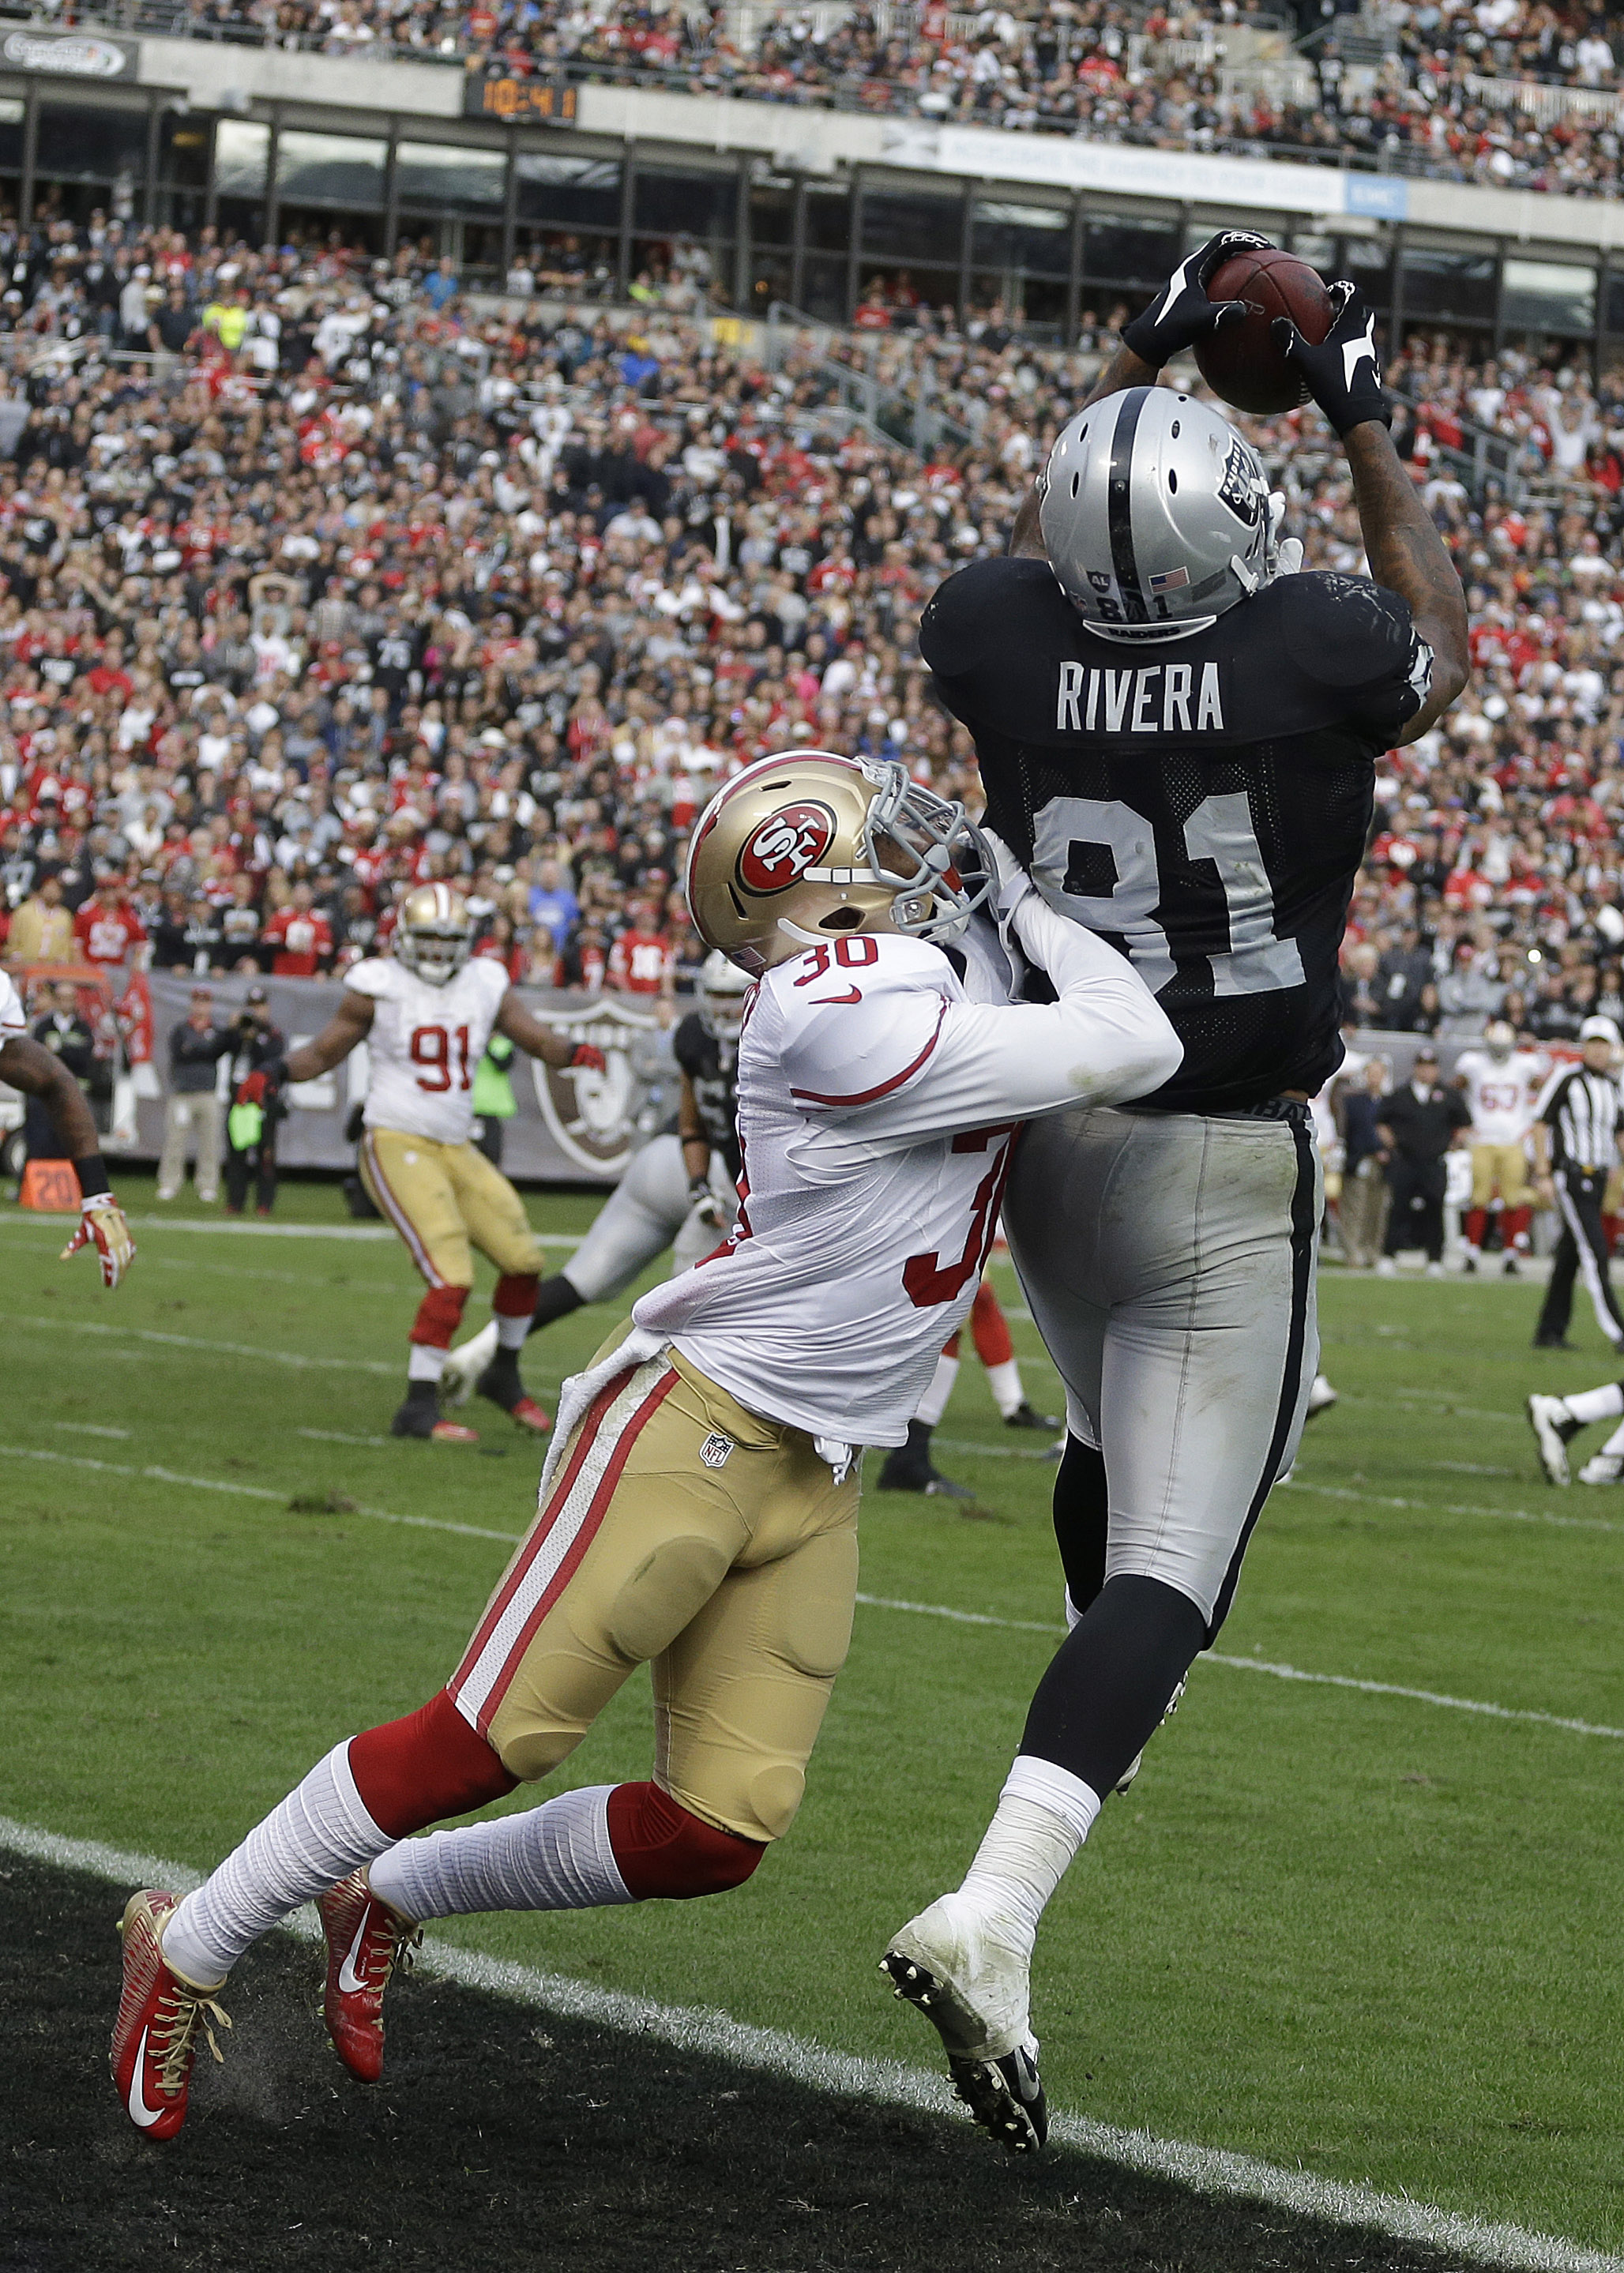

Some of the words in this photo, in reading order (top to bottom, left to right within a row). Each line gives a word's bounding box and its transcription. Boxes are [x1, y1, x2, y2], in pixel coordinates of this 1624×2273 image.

[483, 78, 576, 118] 10:41
[1091, 575, 1109, 587] AL
[1057, 661, 1224, 732] RIVERA
[1030, 791, 1306, 997] 81
[792, 936, 879, 987] 30
[411, 1025, 471, 1091] 91
[35, 1170, 73, 1207] 20
[704, 1445, 723, 1463] NFL
